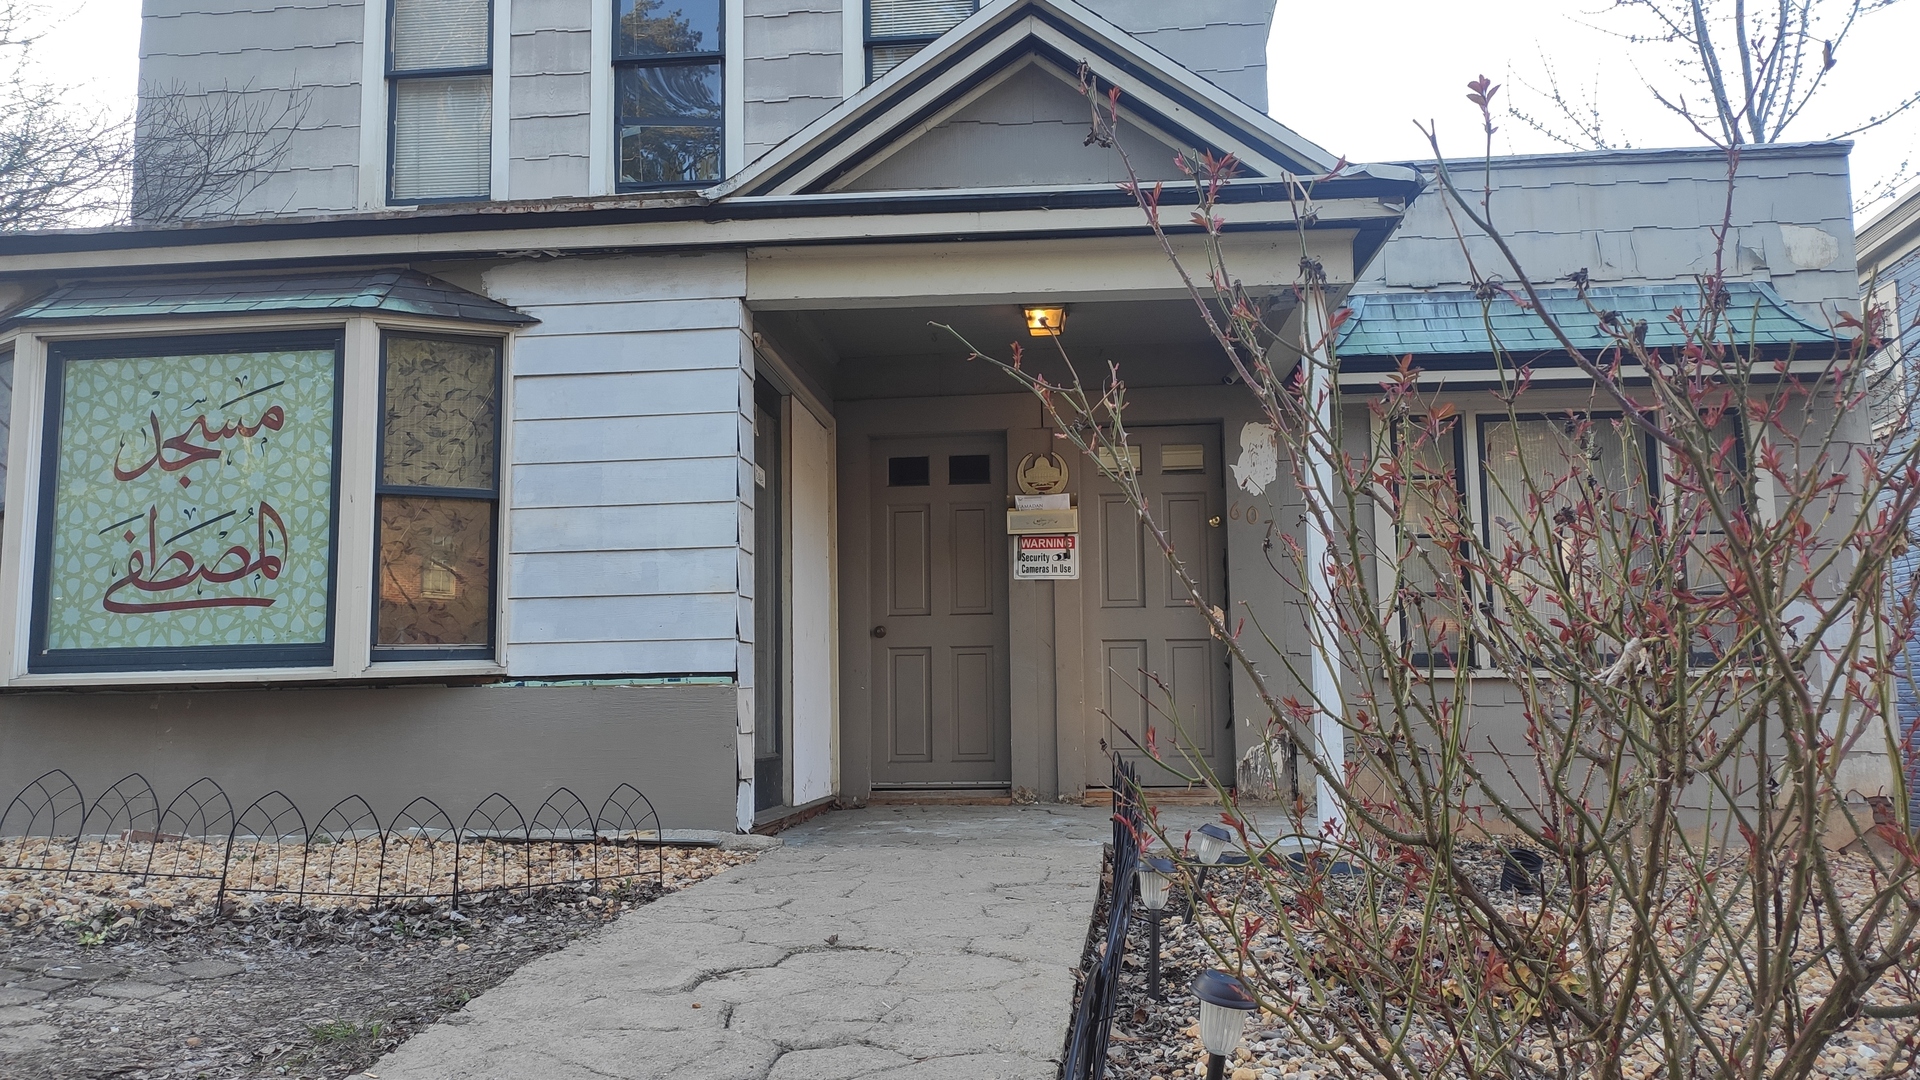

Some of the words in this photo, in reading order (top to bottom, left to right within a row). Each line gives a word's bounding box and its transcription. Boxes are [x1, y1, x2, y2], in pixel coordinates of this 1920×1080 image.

[113, 376, 286, 490] مسجد
[1021, 538, 1073, 548] WARNING
[1021, 552, 1050, 563] Security
[1021, 564, 1050, 574] Cameras
[1051, 564, 1058, 573] In
[1060, 564, 1072, 573] Use
